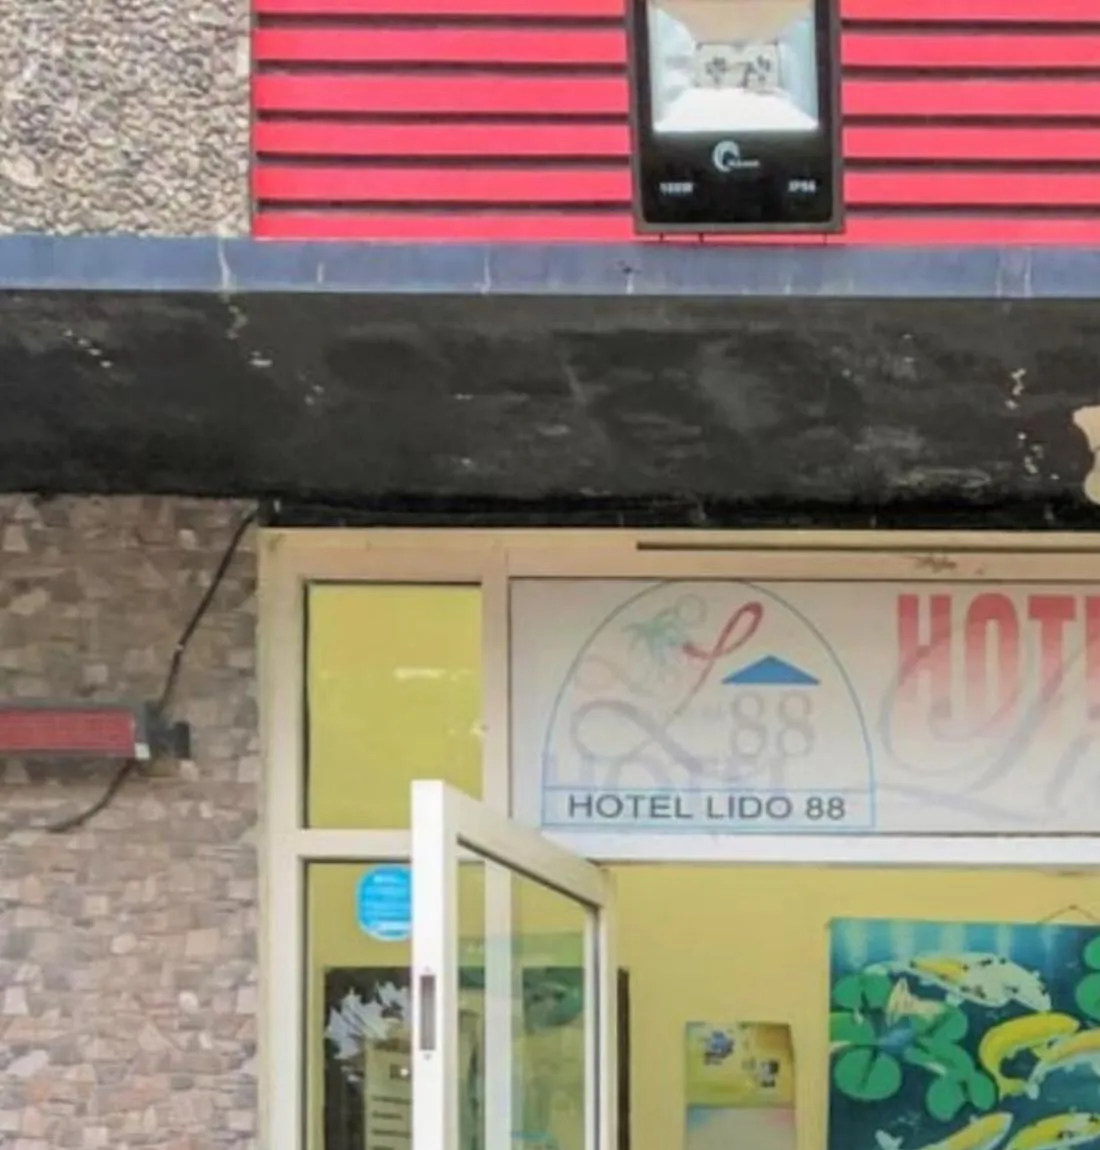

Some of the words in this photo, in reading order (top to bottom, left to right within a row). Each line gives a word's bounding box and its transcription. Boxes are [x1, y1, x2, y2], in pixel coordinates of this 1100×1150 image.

[567, 793, 694, 819] HOTEL
[705, 795, 794, 820] LIDO
[804, 795, 847, 821] 88
